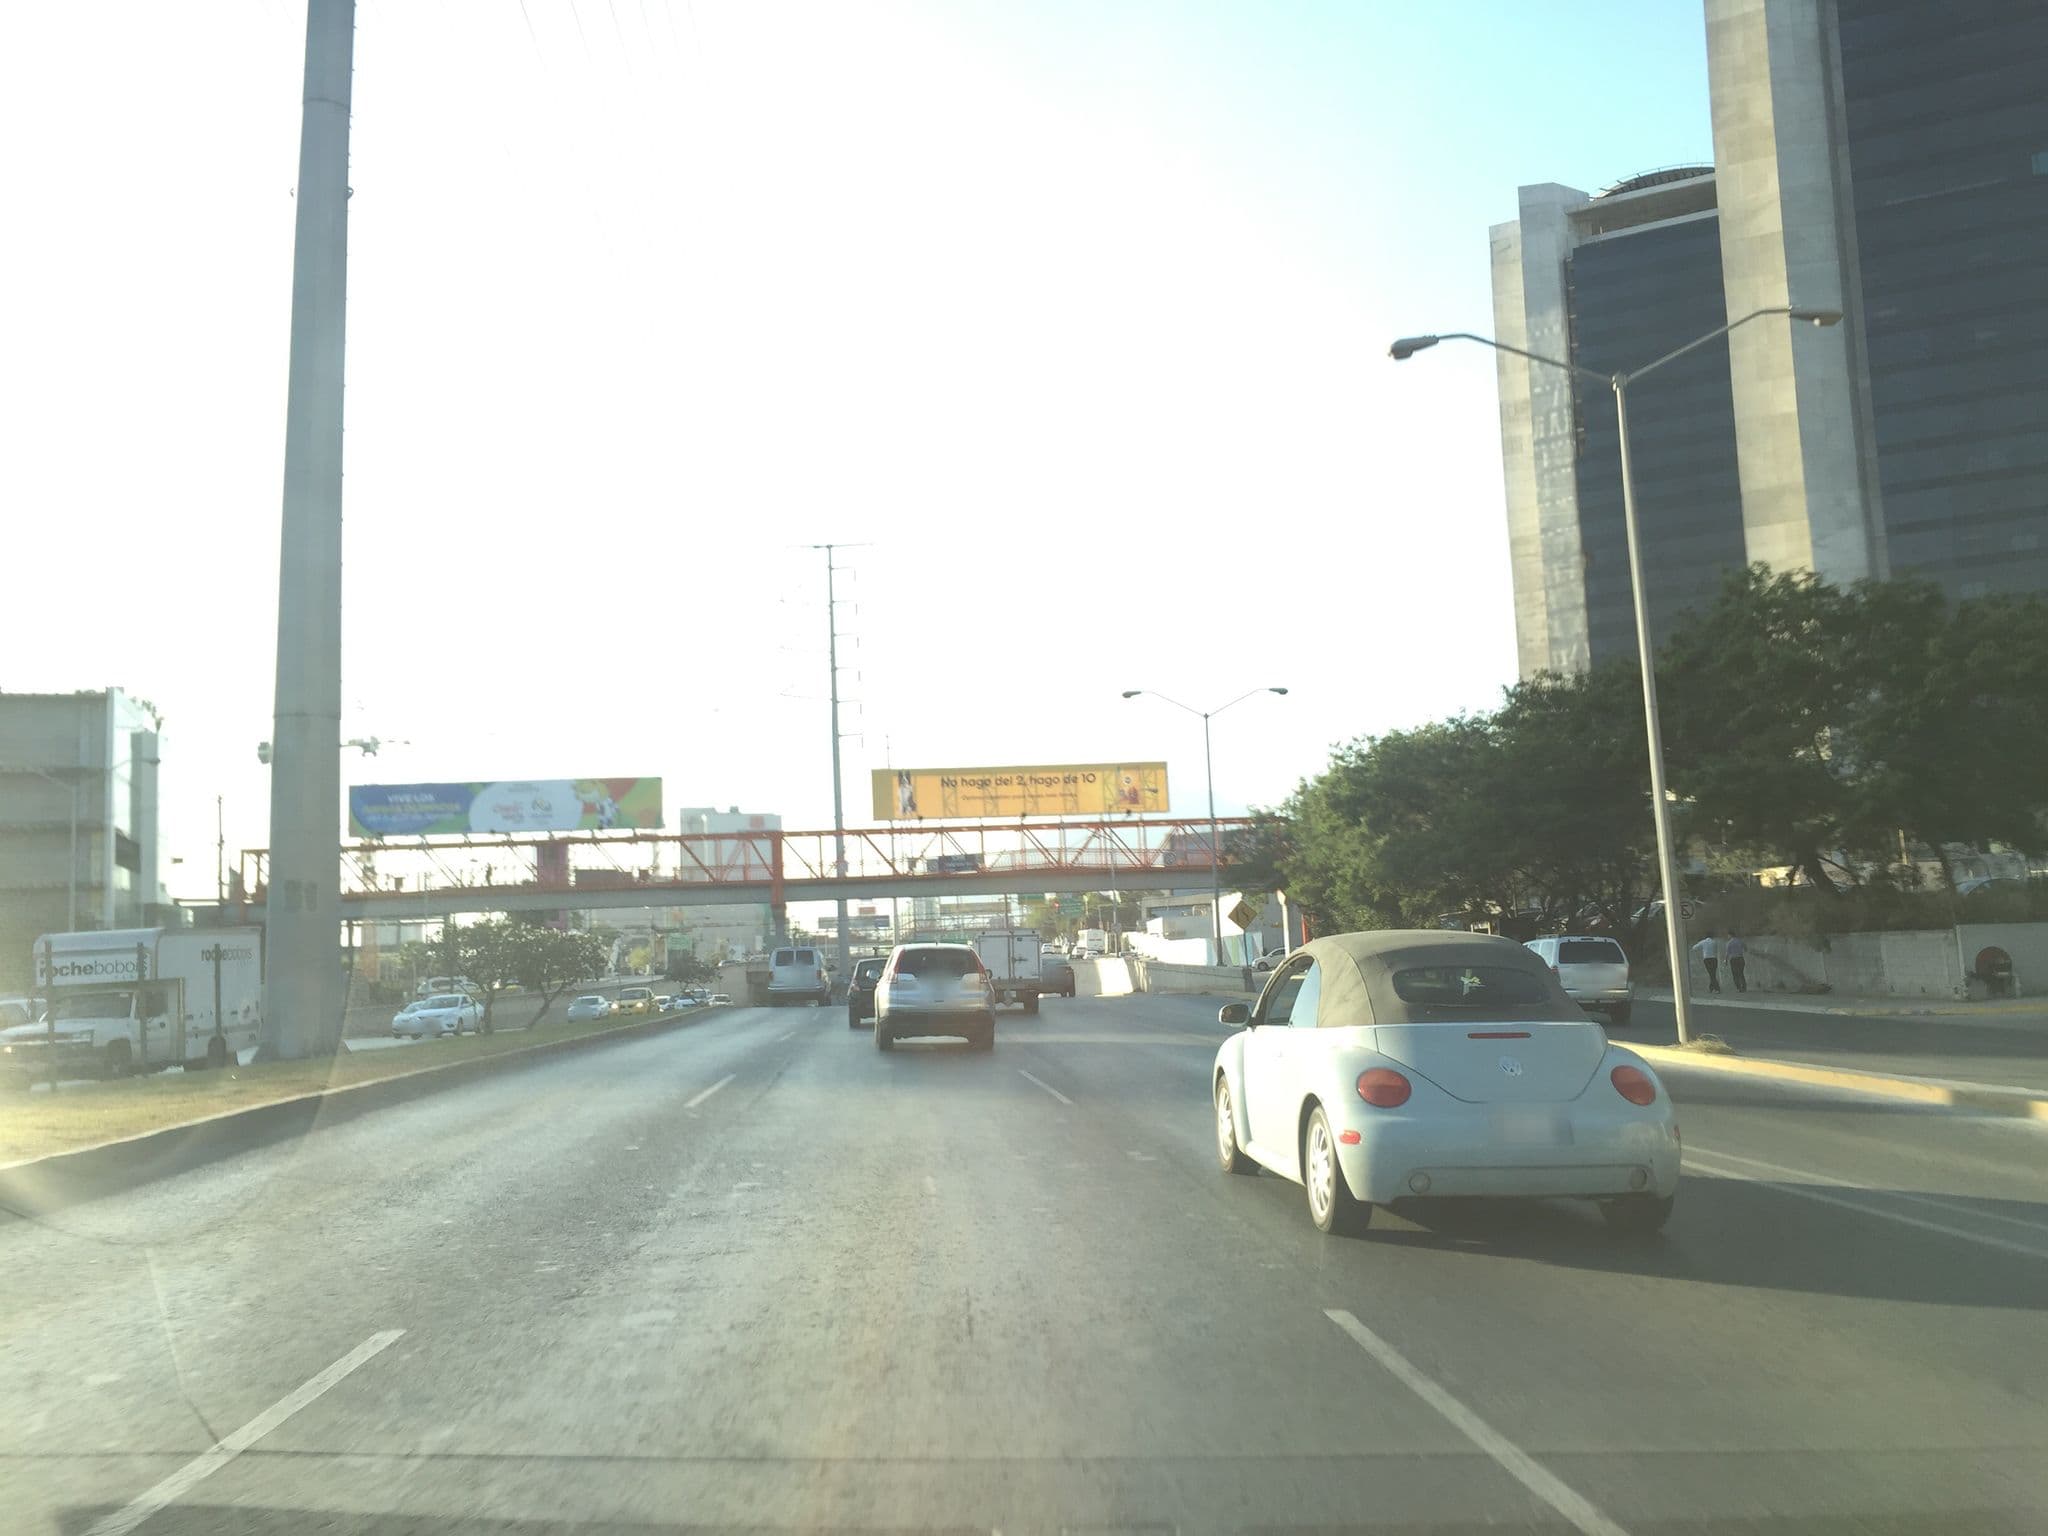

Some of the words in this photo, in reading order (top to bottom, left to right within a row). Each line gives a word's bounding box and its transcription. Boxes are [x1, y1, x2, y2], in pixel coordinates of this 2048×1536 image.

[941, 776, 957, 787] No
[961, 776, 991, 789] hago
[995, 775, 1012, 786] del
[1029, 774, 1060, 787] hago
[1063, 774, 1078, 784] de
[1081, 773, 1097, 783] 10
